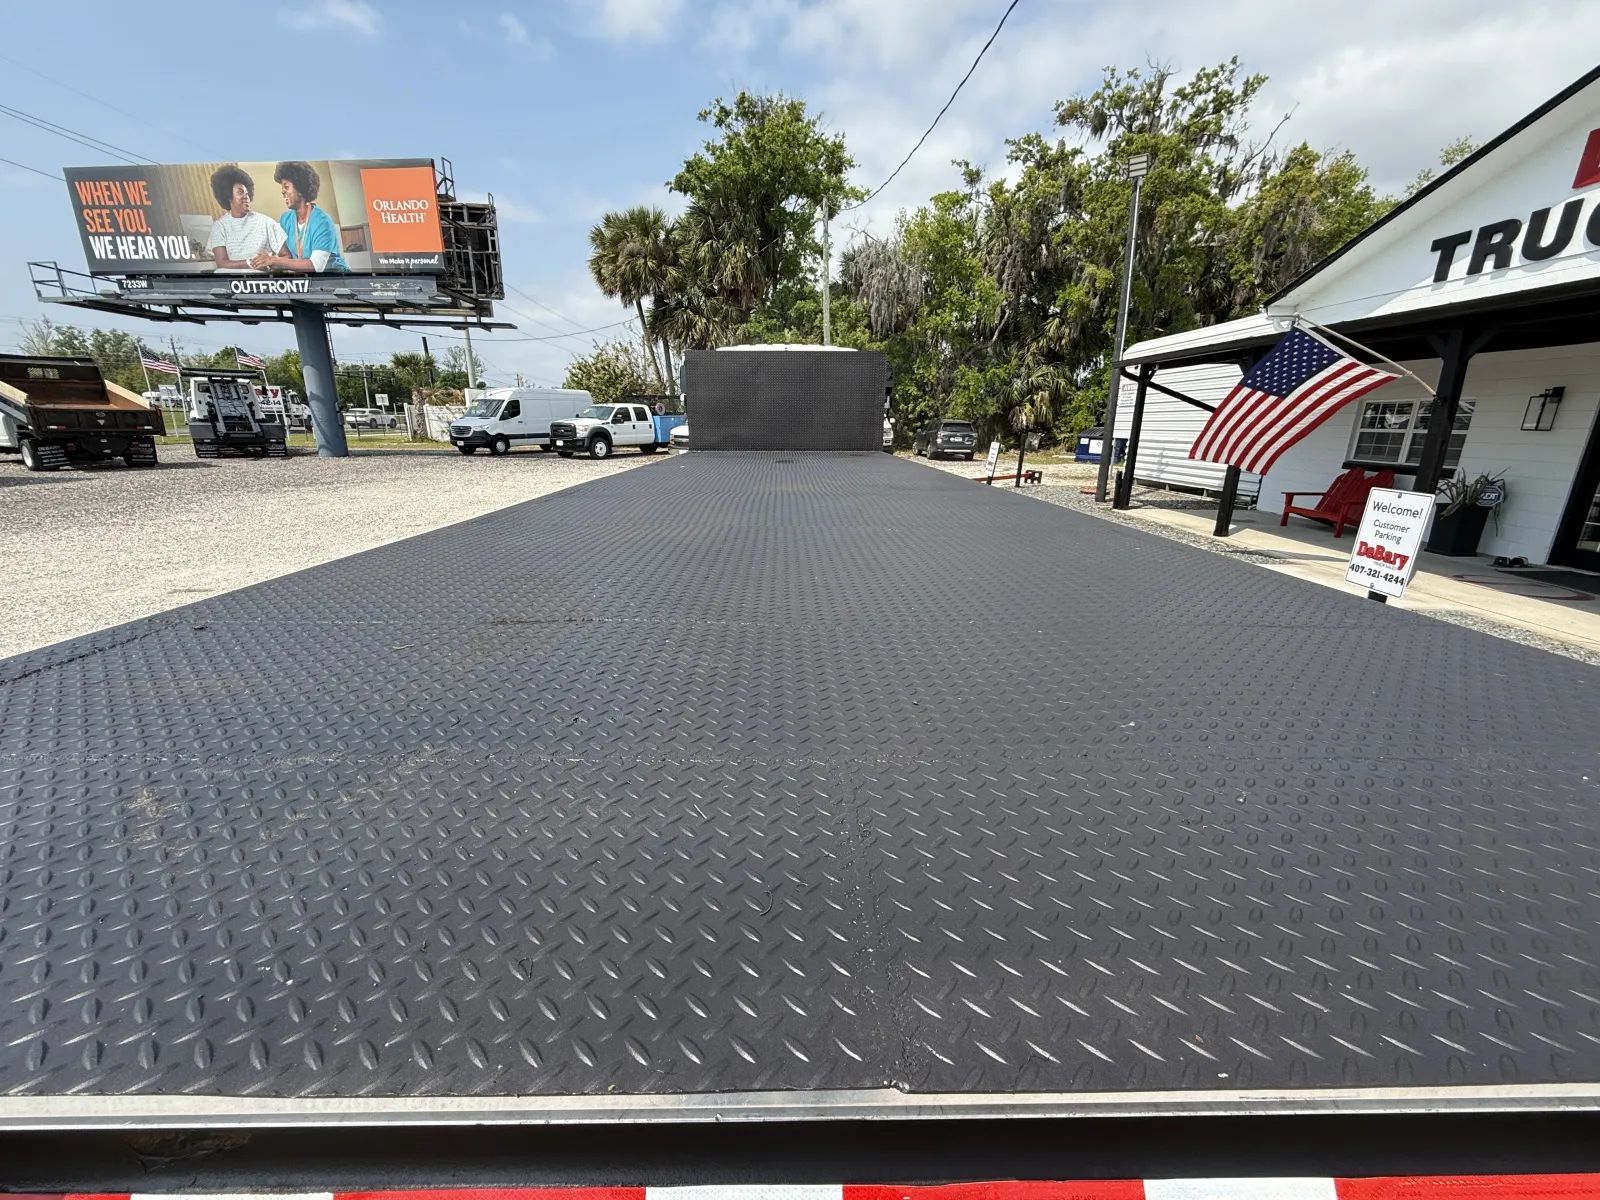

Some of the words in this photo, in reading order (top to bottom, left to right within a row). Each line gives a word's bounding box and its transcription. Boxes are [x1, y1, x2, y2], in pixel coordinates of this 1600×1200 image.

[74, 181, 125, 205] WHEN
[123, 181, 152, 205] WE
[373, 199, 429, 211] ORLANDO
[82, 208, 114, 233] SEE
[113, 208, 152, 235] YOU,
[381, 212, 425, 223] HEALTH
[89, 235, 117, 260] WE
[116, 235, 160, 260] HEAR
[157, 235, 196, 260] YOU.
[410, 254, 439, 269] personal
[121, 279, 148, 289] 7233W
[1372, 501, 1424, 519] Welcome!
[1373, 519, 1411, 533] Customer
[1374, 531, 1402, 545] Parking
[1356, 541, 1410, 571] DeBary
[1349, 563, 1405, 586] 407-321-4244
